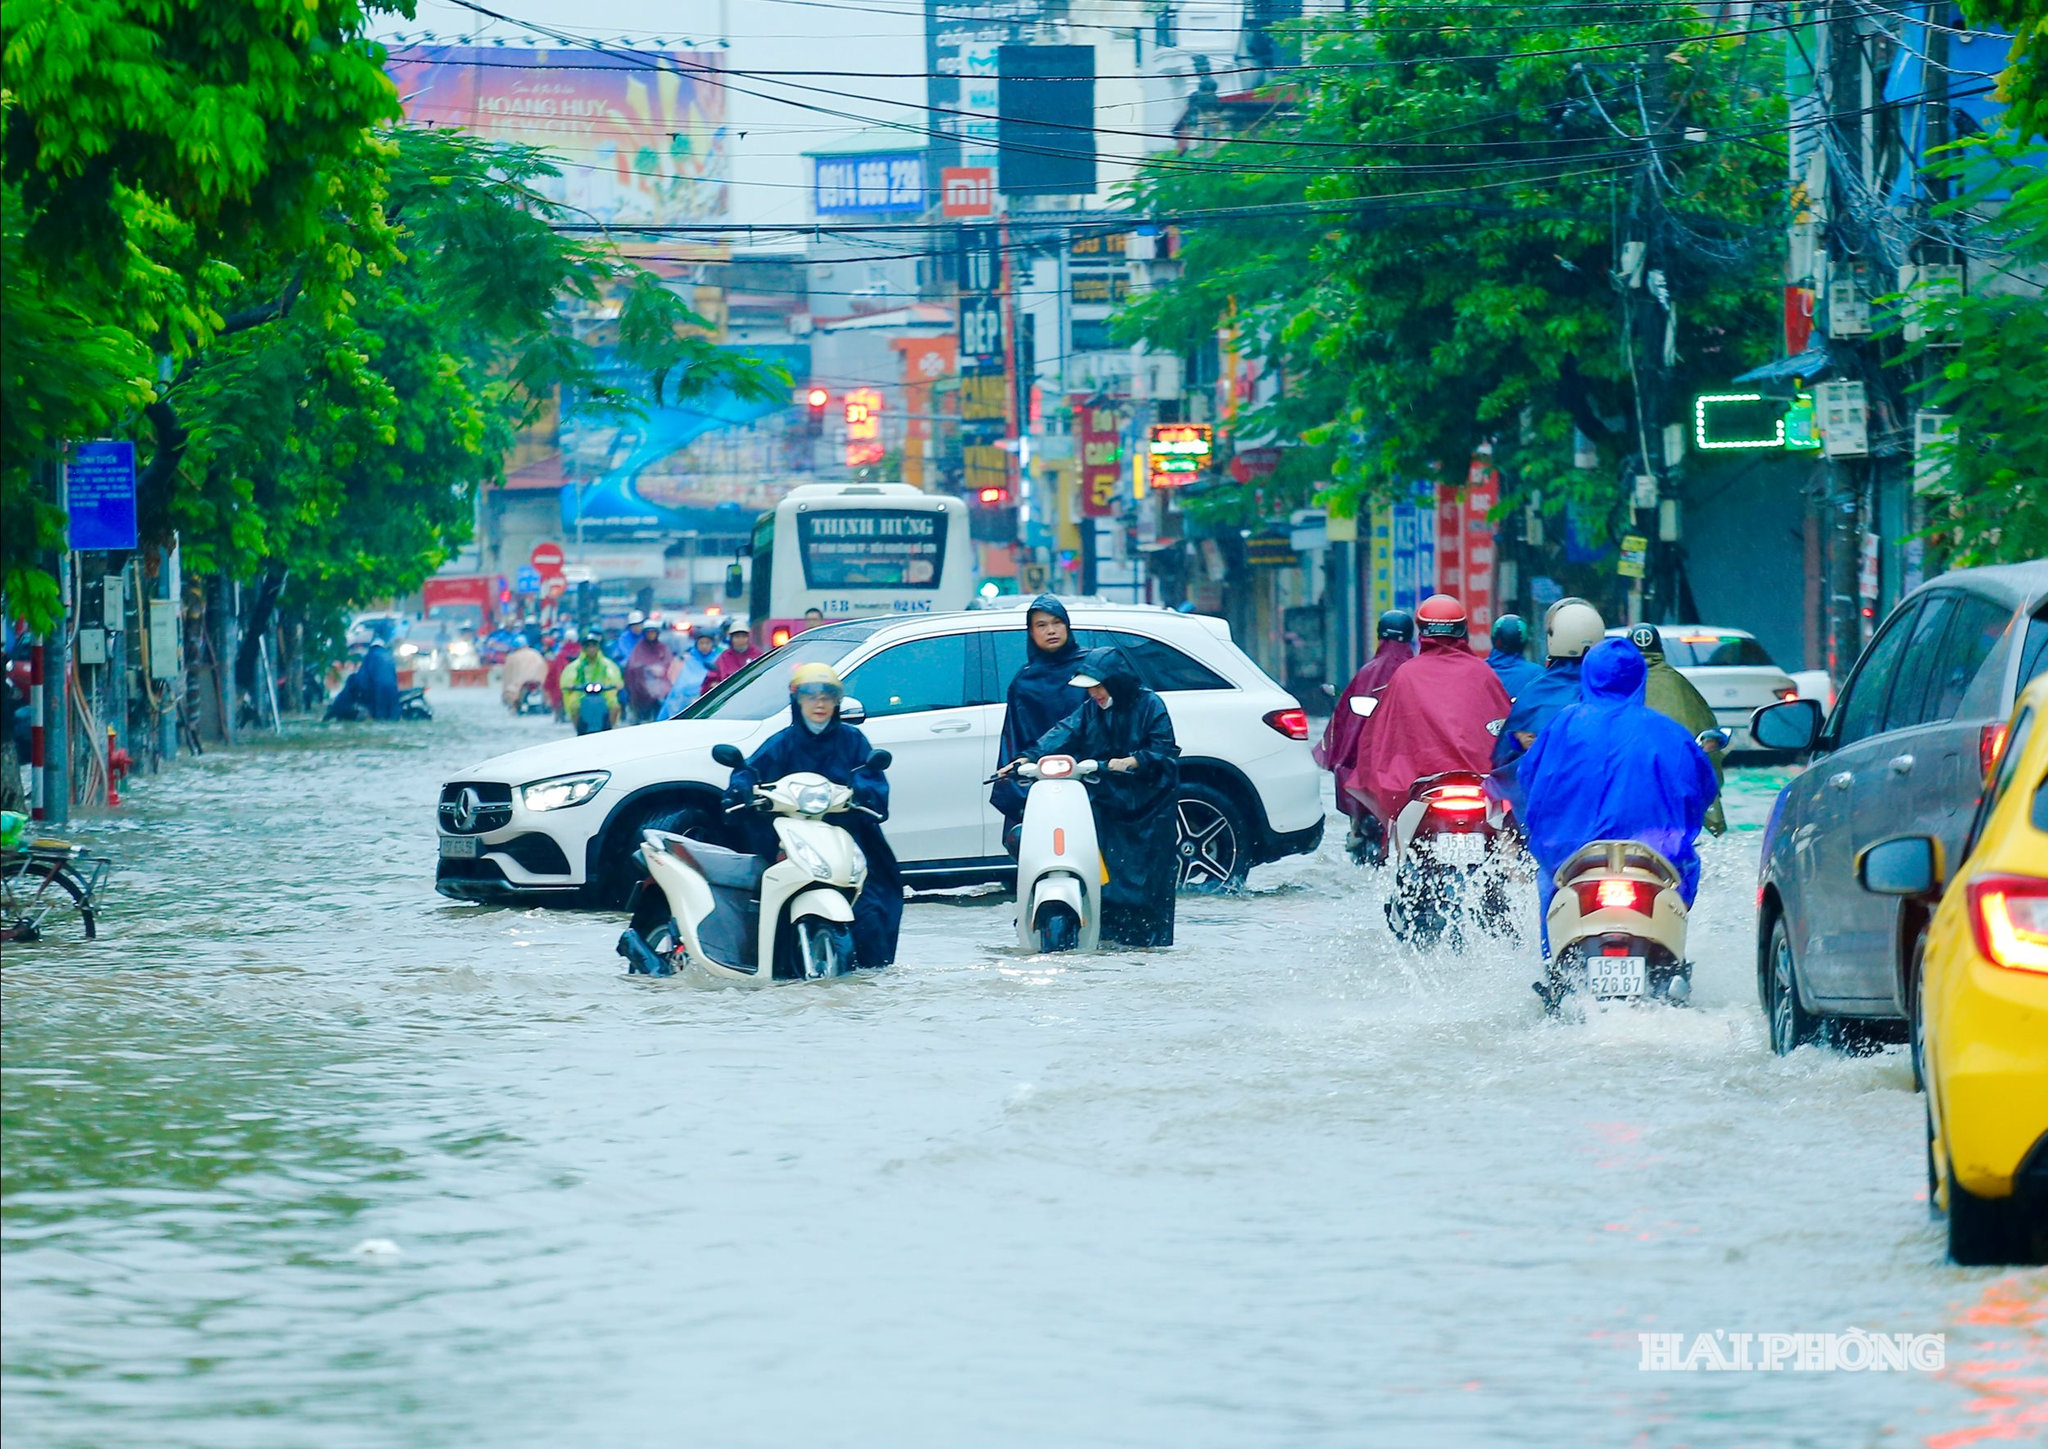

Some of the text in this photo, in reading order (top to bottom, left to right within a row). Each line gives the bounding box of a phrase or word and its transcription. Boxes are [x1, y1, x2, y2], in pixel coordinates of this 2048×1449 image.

[560, 99, 608, 117] HUY
[810, 518, 874, 538] THỊNH
[1597, 960, 1635, 976] 15-B1
